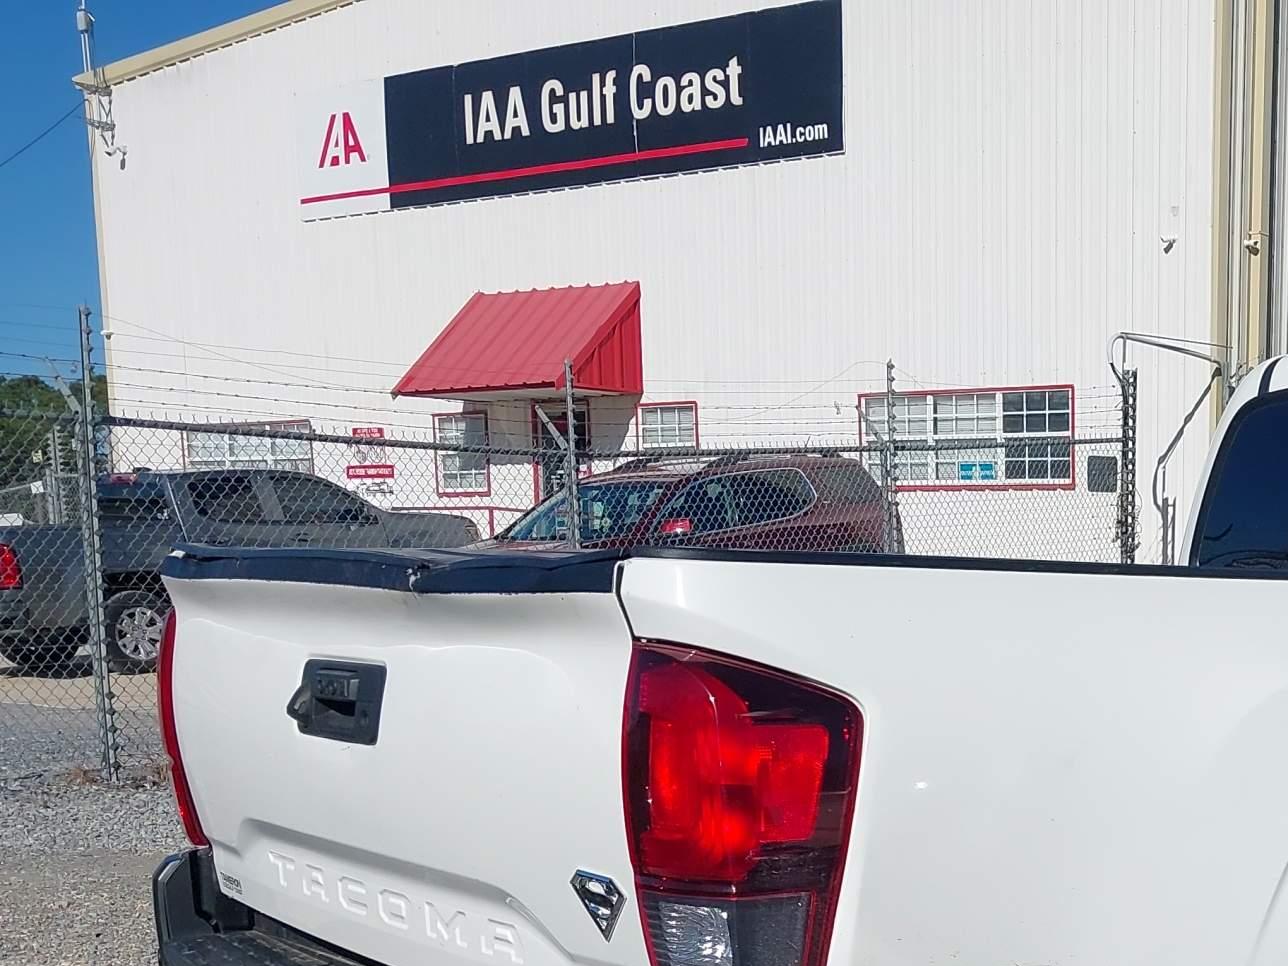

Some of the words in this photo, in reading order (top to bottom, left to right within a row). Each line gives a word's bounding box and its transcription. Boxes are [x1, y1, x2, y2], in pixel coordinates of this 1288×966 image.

[464, 86, 530, 145] IAA
[541, 70, 616, 133] Gulf
[629, 56, 743, 119] Coast
[759, 122, 829, 148] IAAI.com
[267, 850, 524, 965] TACOMA
